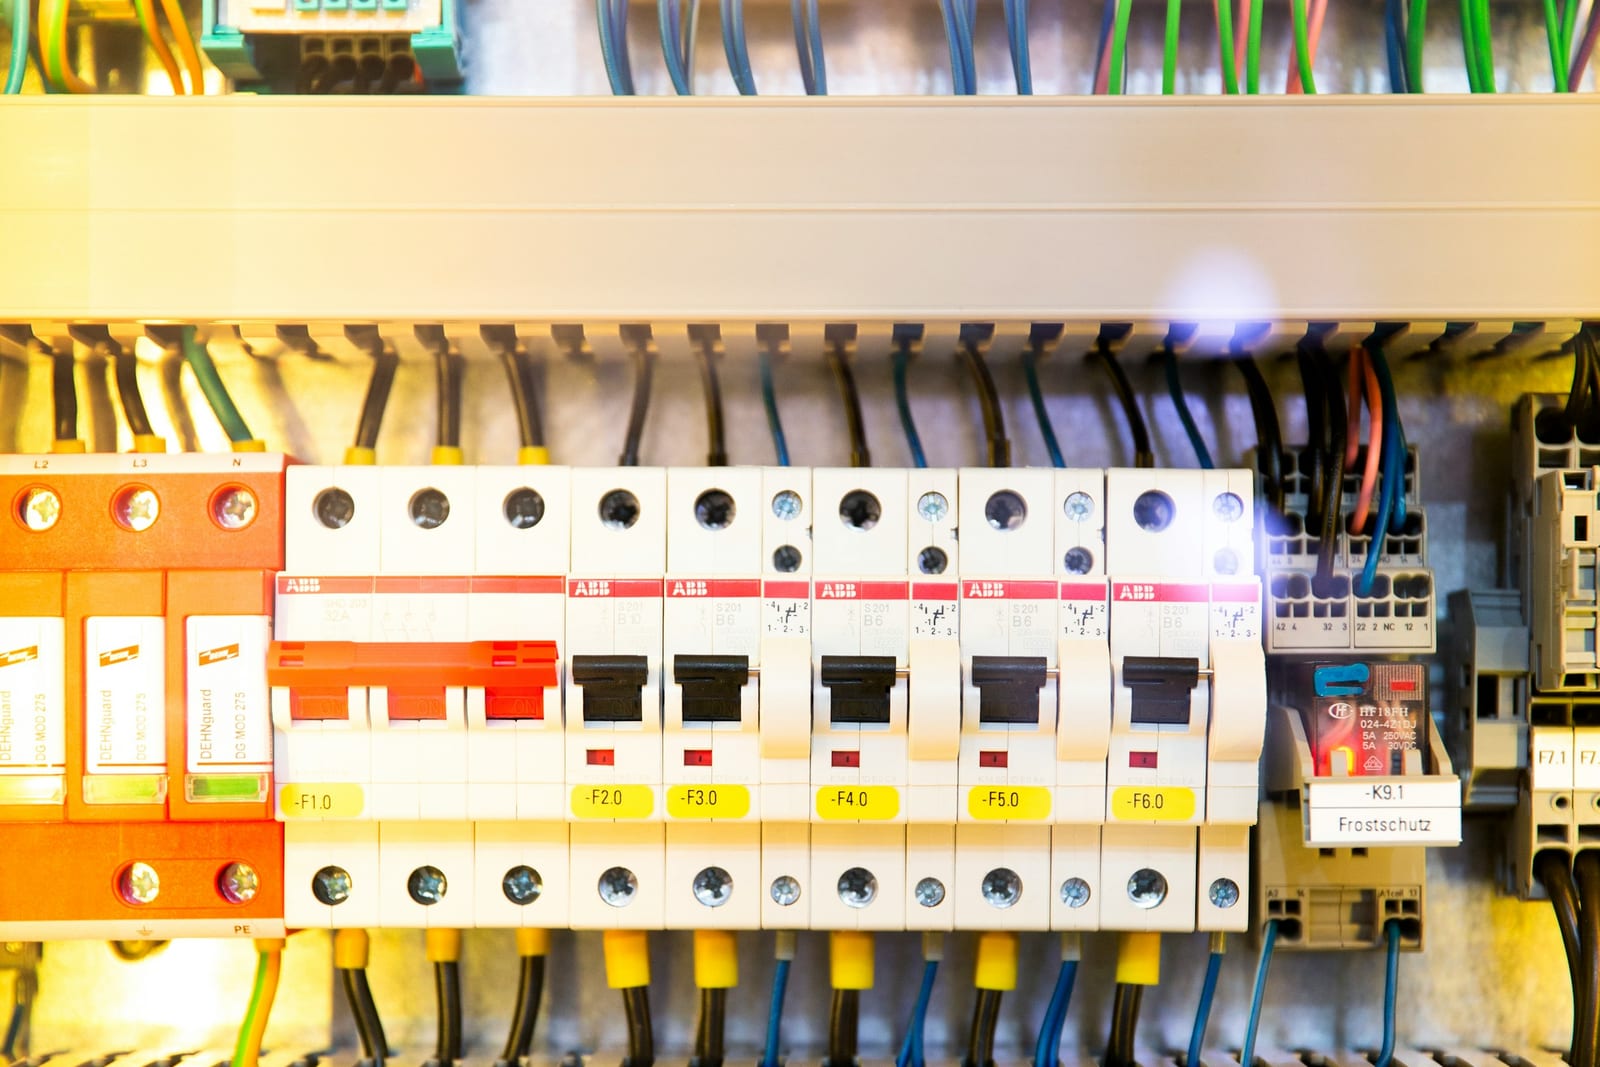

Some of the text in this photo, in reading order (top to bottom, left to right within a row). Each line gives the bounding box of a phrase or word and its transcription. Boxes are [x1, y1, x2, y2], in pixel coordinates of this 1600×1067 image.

[33, 460, 49, 469] L2
[132, 459, 148, 468] L3
[232, 458, 242, 467] N
[286, 579, 320, 593] ABB
[575, 581, 610, 596] ABB
[672, 581, 708, 596] ABB
[821, 583, 857, 598] ABB
[969, 582, 1005, 597] ABB
[1120, 585, 1155, 600] ABB
[1276, 622, 1348, 631] 42 4 32 3
[1356, 622, 1366, 631] 22
[1373, 622, 1378, 631] 2
[1384, 622, 1395, 631] NC
[1404, 622, 1413, 631] 12
[1360, 707, 1409, 717] HF18FH
[35, 693, 46, 761] DG MOD 275
[100, 689, 115, 760] DEHNguard
[200, 689, 214, 760] DEHNguard
[235, 691, 246, 760] DG MOD 275
[1362, 731, 1416, 740] 5A 250VAC
[1362, 741, 1416, 751] 5A 30VDC
[1538, 750, 1566, 765] F7.1
[585, 788, 623, 806] -F2.0
[680, 789, 718, 806] -F3.0
[831, 790, 868, 808] -F4.0
[982, 791, 1019, 808] -F5.0
[1365, 784, 1404, 801] -K9.1
[294, 793, 332, 810] -F1.0
[1127, 792, 1164, 809] -F6.0
[1339, 816, 1432, 832] Frostschutz
[234, 925, 251, 935] PE
